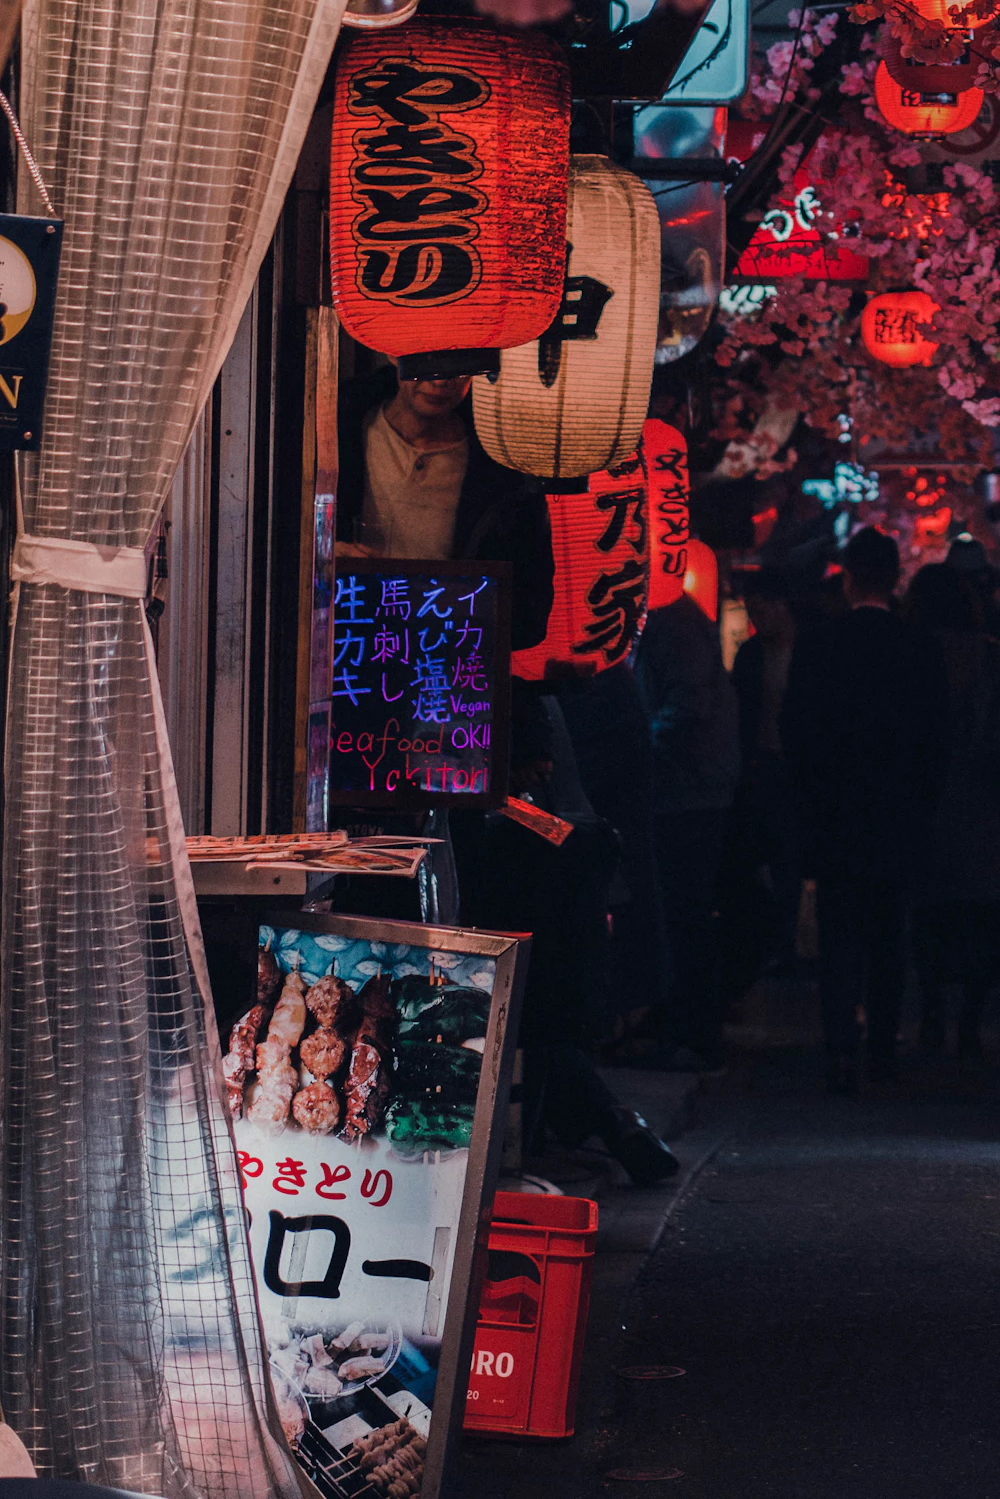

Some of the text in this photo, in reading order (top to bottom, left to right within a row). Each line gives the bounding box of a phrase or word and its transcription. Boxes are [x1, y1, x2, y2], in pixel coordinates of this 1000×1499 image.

[350, 59, 490, 303] やきとり
[333, 576, 375, 706] 生カキ
[371, 580, 412, 703] 馬刺し
[410, 578, 454, 723] えび塩焼
[451, 576, 490, 691] イカ焼
[451, 694, 490, 718] Vegan
[237, 1150, 394, 1207] やきとり
[470, 1349, 515, 1378] RO
